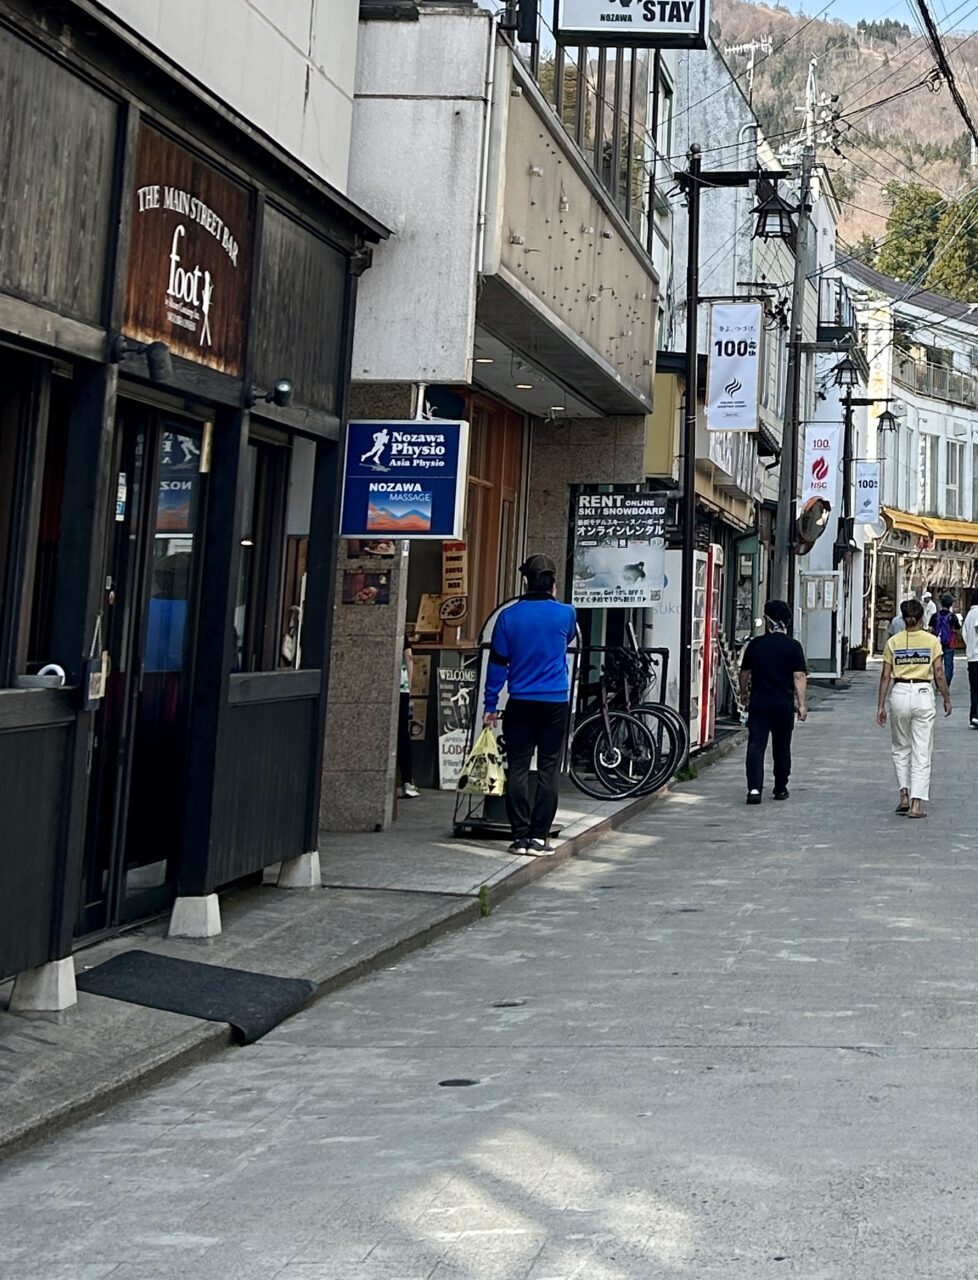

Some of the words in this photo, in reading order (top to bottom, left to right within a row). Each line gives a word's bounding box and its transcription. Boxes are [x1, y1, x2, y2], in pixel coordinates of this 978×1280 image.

[642, 0, 695, 23] STAY
[600, 13, 633, 23] NOZAWA
[137, 185, 161, 212] THE
[163, 186, 191, 216] MAIN
[189, 197, 224, 241] STREET
[221, 225, 239, 267] BAR
[166, 224, 203, 307] foot
[391, 431, 445, 443] Nozawa
[390, 443, 446, 458] Physio
[388, 459, 411, 467] Asia
[412, 459, 445, 469] Physio
[369, 482, 423, 492] NOZAWA
[810, 481, 828, 489] NSC
[388, 493, 431, 502] MASSAGE
[578, 495, 625, 508] RENT
[625, 499, 655, 507] ONLINE
[578, 507, 596, 516] SKI
[602, 507, 666, 516] SNOWBOARD
[576, 525, 665, 537] オンラインレンタル
[440, 669, 477, 682] WELCOME
